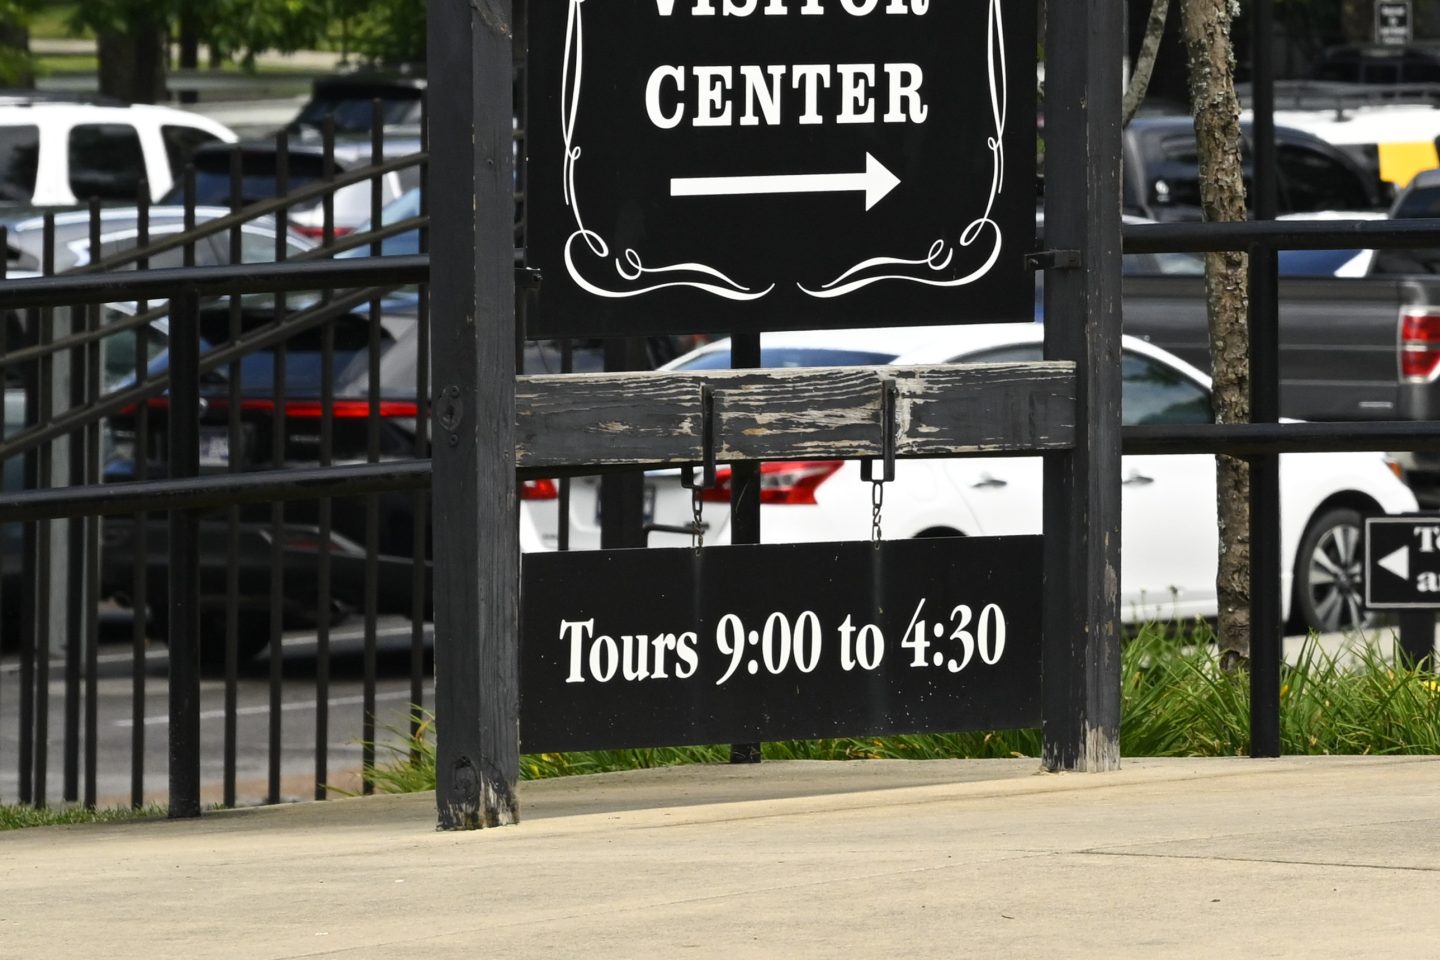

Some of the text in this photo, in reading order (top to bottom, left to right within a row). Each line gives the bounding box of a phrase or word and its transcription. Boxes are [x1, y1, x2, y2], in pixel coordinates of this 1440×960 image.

[645, 62, 929, 129] CENTER
[559, 597, 1007, 685] Tours 9:00 to 4:30
